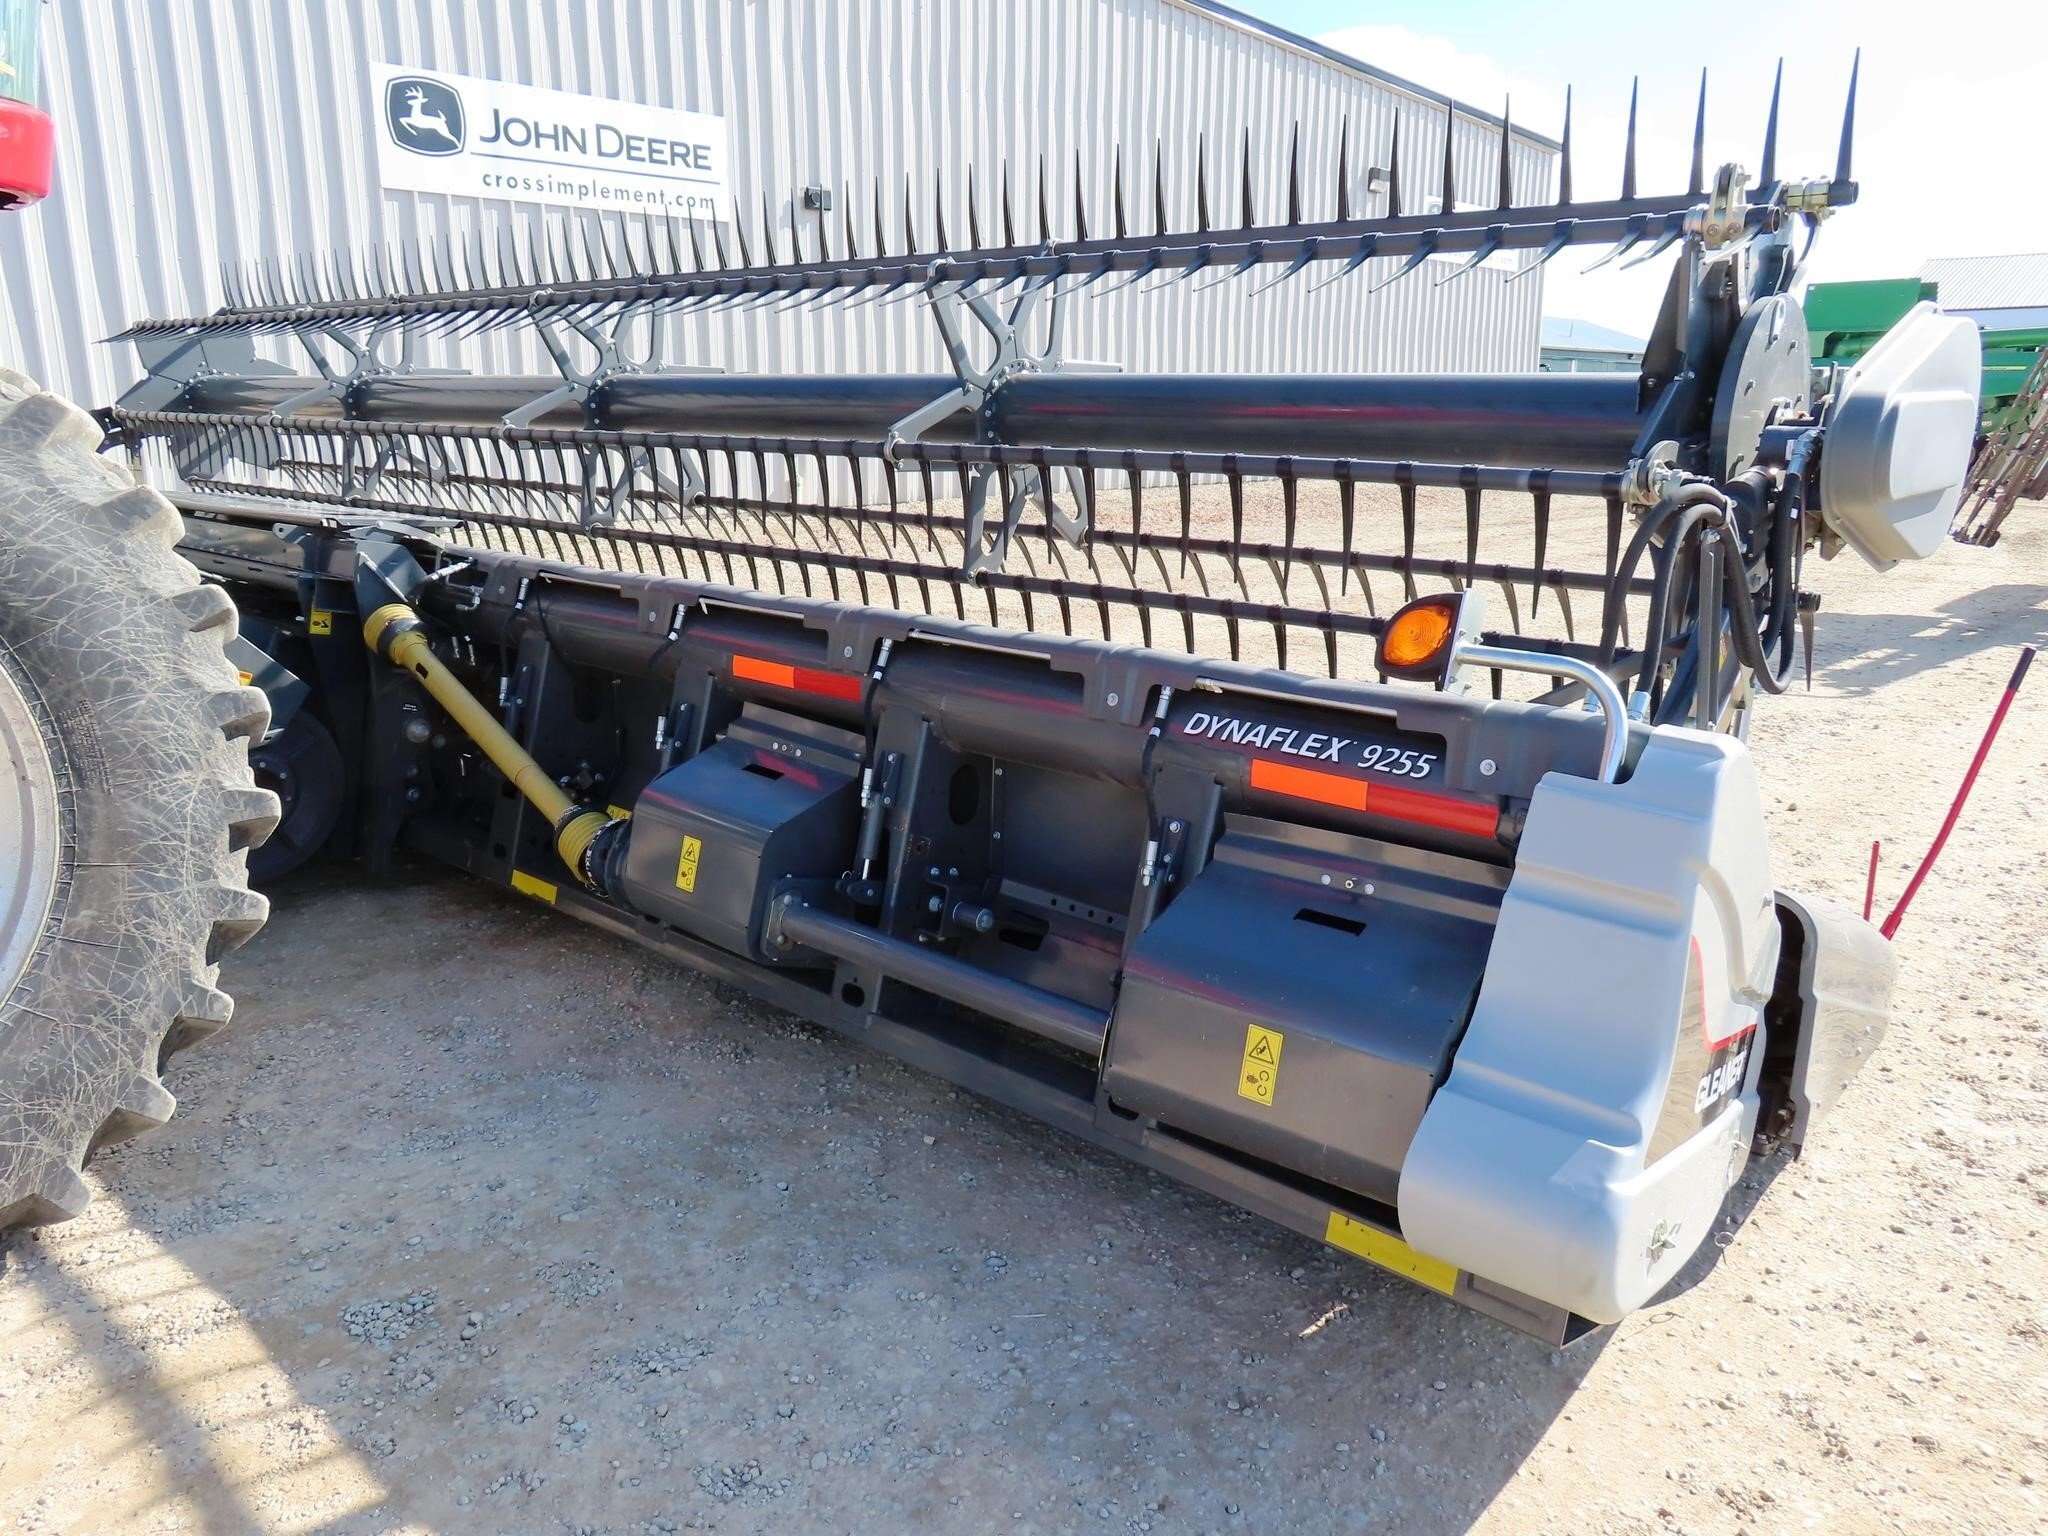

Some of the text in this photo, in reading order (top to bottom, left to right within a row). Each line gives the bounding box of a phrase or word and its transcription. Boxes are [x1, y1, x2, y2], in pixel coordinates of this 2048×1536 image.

[480, 108, 712, 171] JOHN DEERE
[482, 173, 714, 210] crossimplement.com
[1183, 712, 1438, 778] DYNAFLEX 9255
